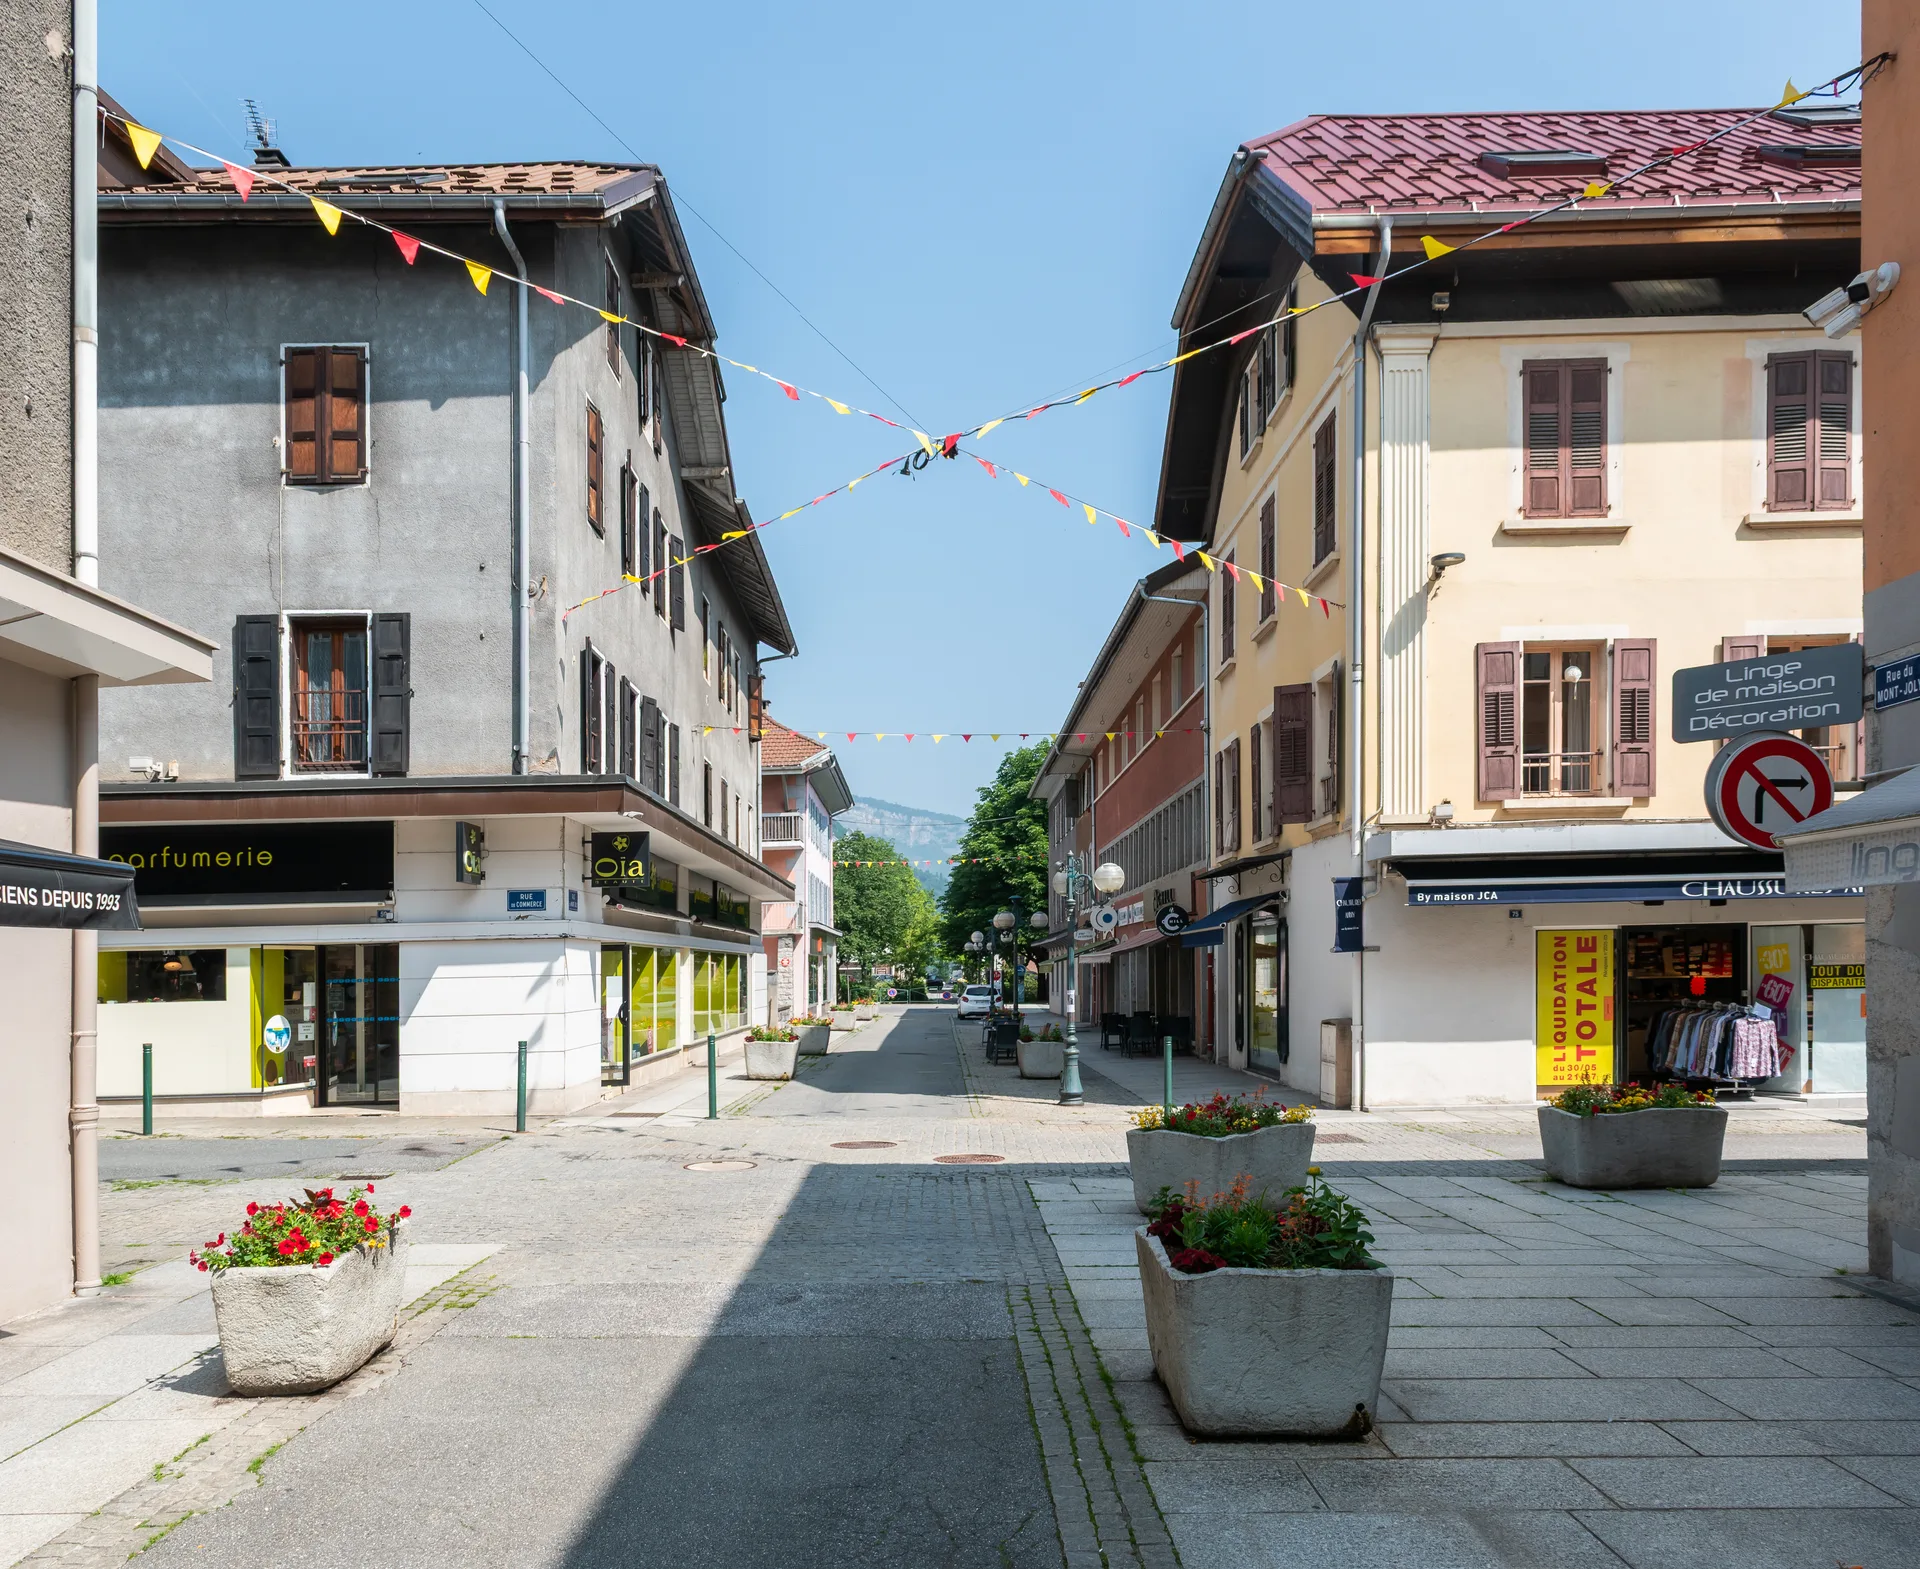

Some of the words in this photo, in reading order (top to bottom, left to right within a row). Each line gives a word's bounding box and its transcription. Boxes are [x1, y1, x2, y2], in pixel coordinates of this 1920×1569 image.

[1726, 661, 1802, 683] Linge
[1886, 670, 1901, 683] Rue
[1903, 664, 1913, 677] du
[1695, 689, 1728, 704] de
[1735, 675, 1836, 700] maison
[1689, 702, 1840, 732] Décoration
[0, 884, 38, 906] IENS
[42, 888, 93, 909] DEPUIS
[96, 893, 121, 911] 1993
[1417, 893, 1431, 903] By
[1434, 892, 1474, 901] maison
[1477, 891, 1498, 900] JCA
[1811, 966, 1841, 977] TOUT
[1553, 936, 1567, 1062] LIQUIDATION
[1576, 936, 1598, 1062] TOTALE
[1567, 1064, 1597, 1072] 30/05
